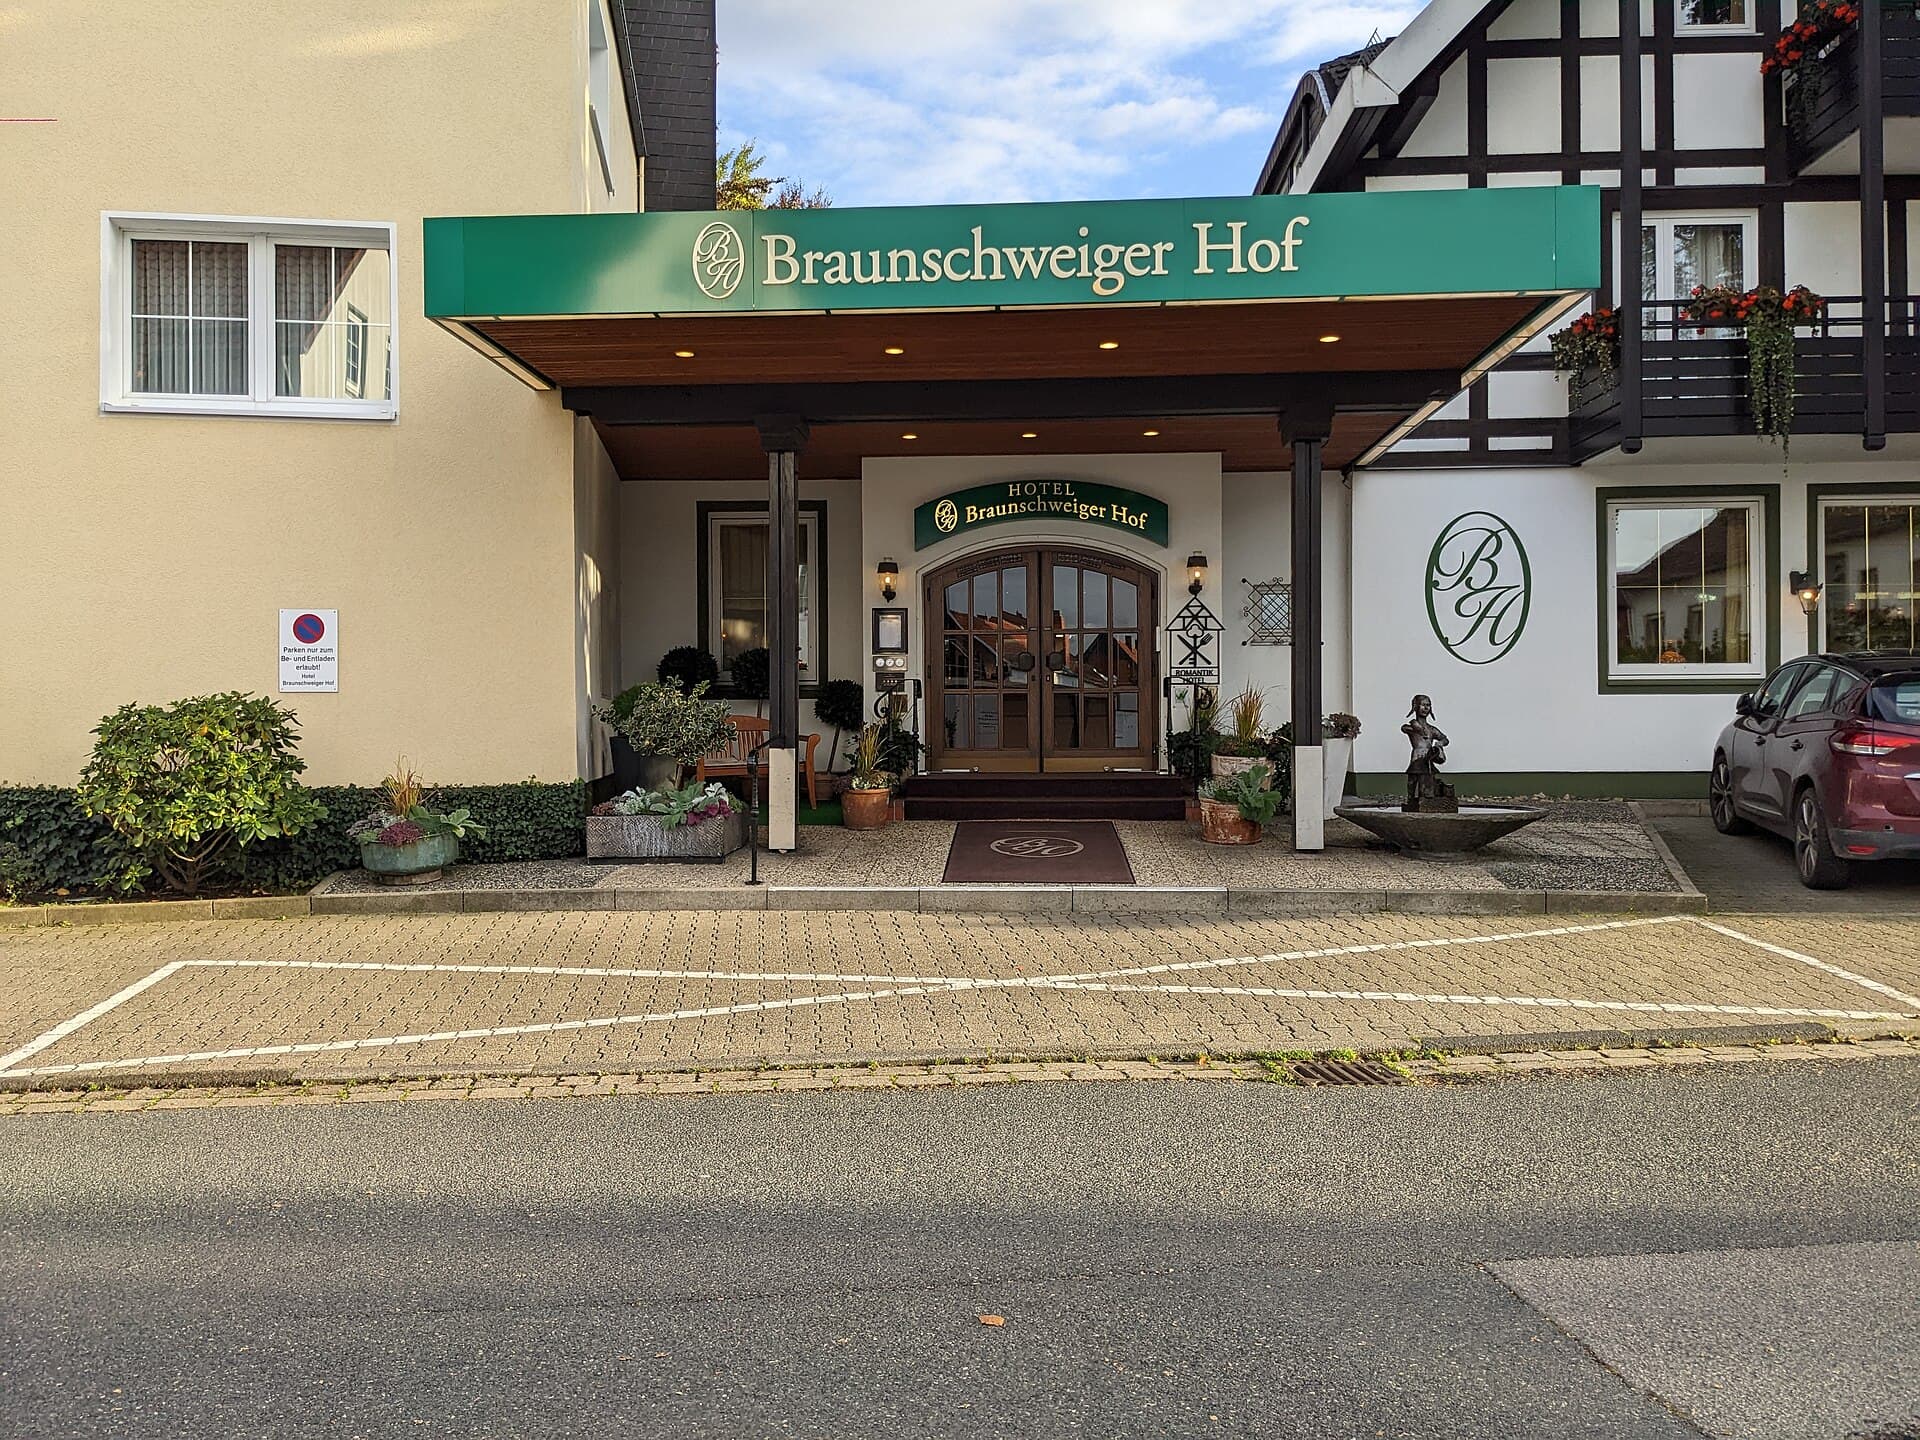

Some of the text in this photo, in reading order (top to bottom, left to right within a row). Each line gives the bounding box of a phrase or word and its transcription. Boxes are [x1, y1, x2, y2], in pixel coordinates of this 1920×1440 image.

[761, 216, 1310, 297] Braunschweiger Hof
[1008, 482, 1075, 497] HOTEL
[965, 495, 1148, 530] Braunschweiger Hof
